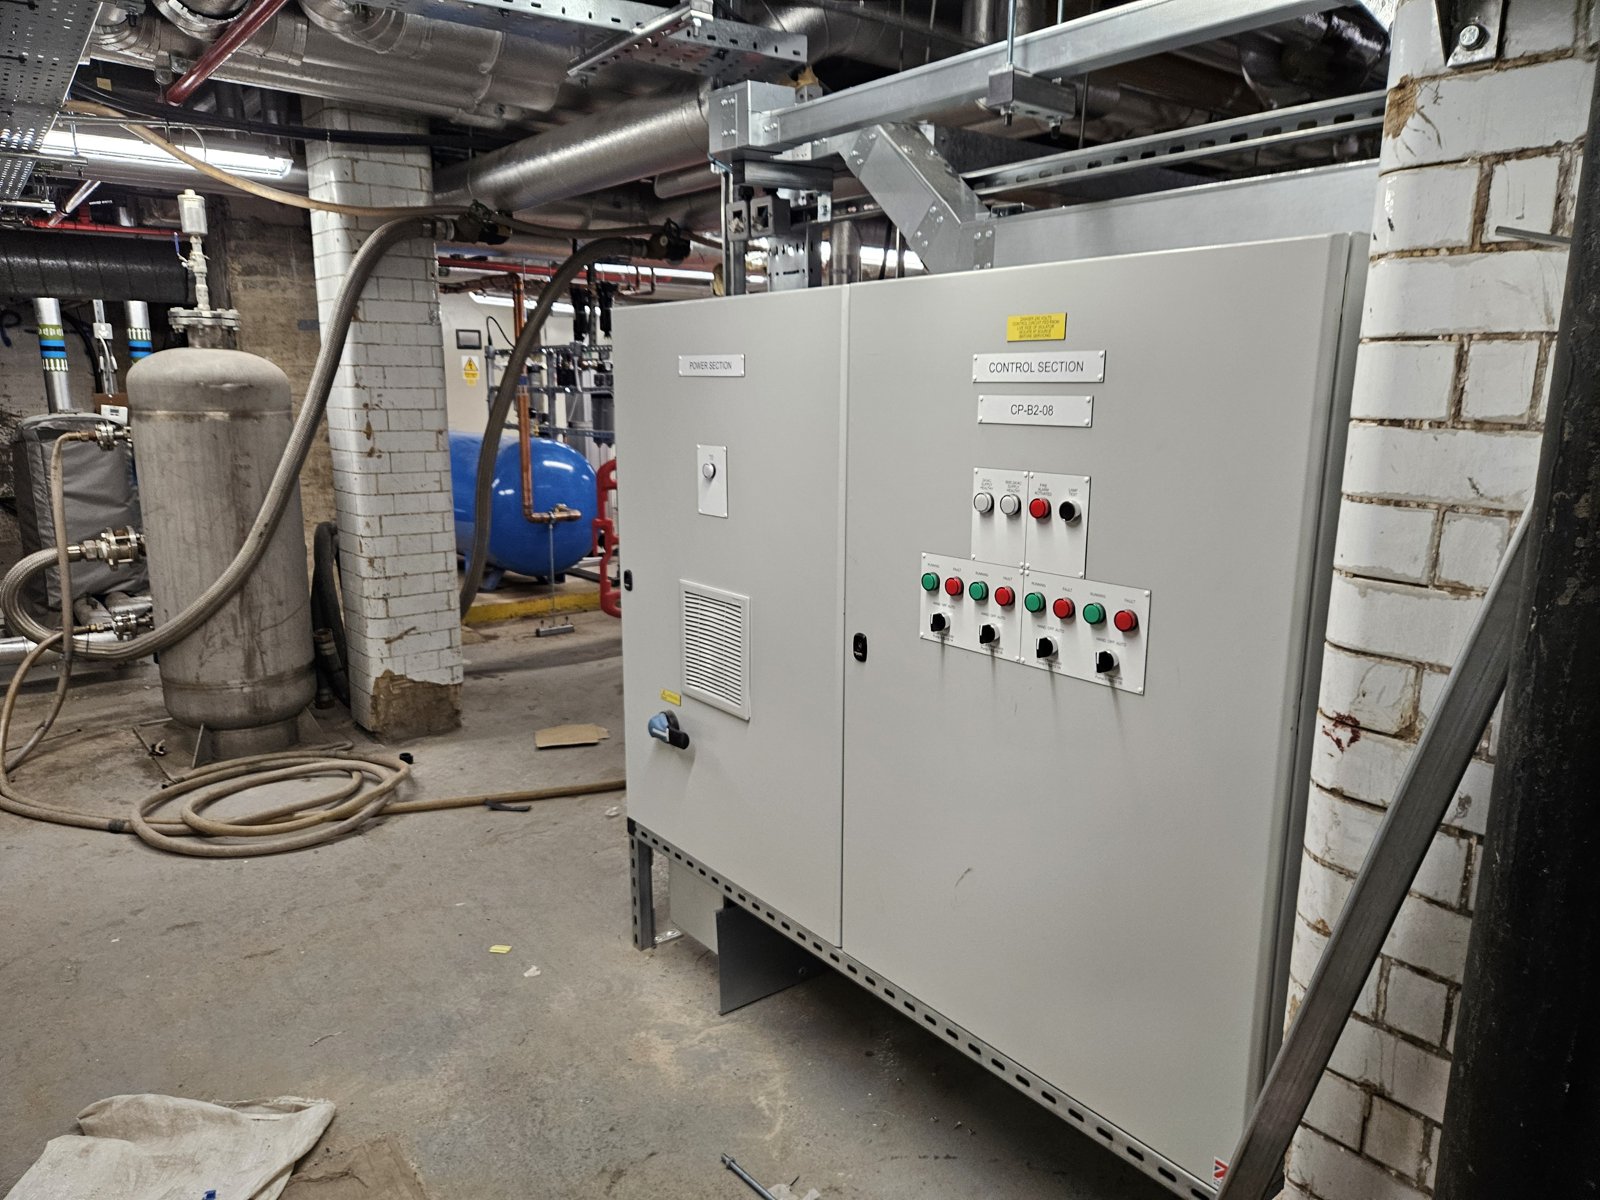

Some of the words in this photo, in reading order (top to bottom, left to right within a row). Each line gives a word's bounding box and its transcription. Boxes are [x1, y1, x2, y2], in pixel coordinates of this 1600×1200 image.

[689, 361, 708, 370] POWER
[709, 360, 732, 370] SECTION
[988, 361, 1035, 373] CONTROL
[1038, 361, 1084, 373] SECTION
[1010, 404, 1054, 417] CP-B2-08
